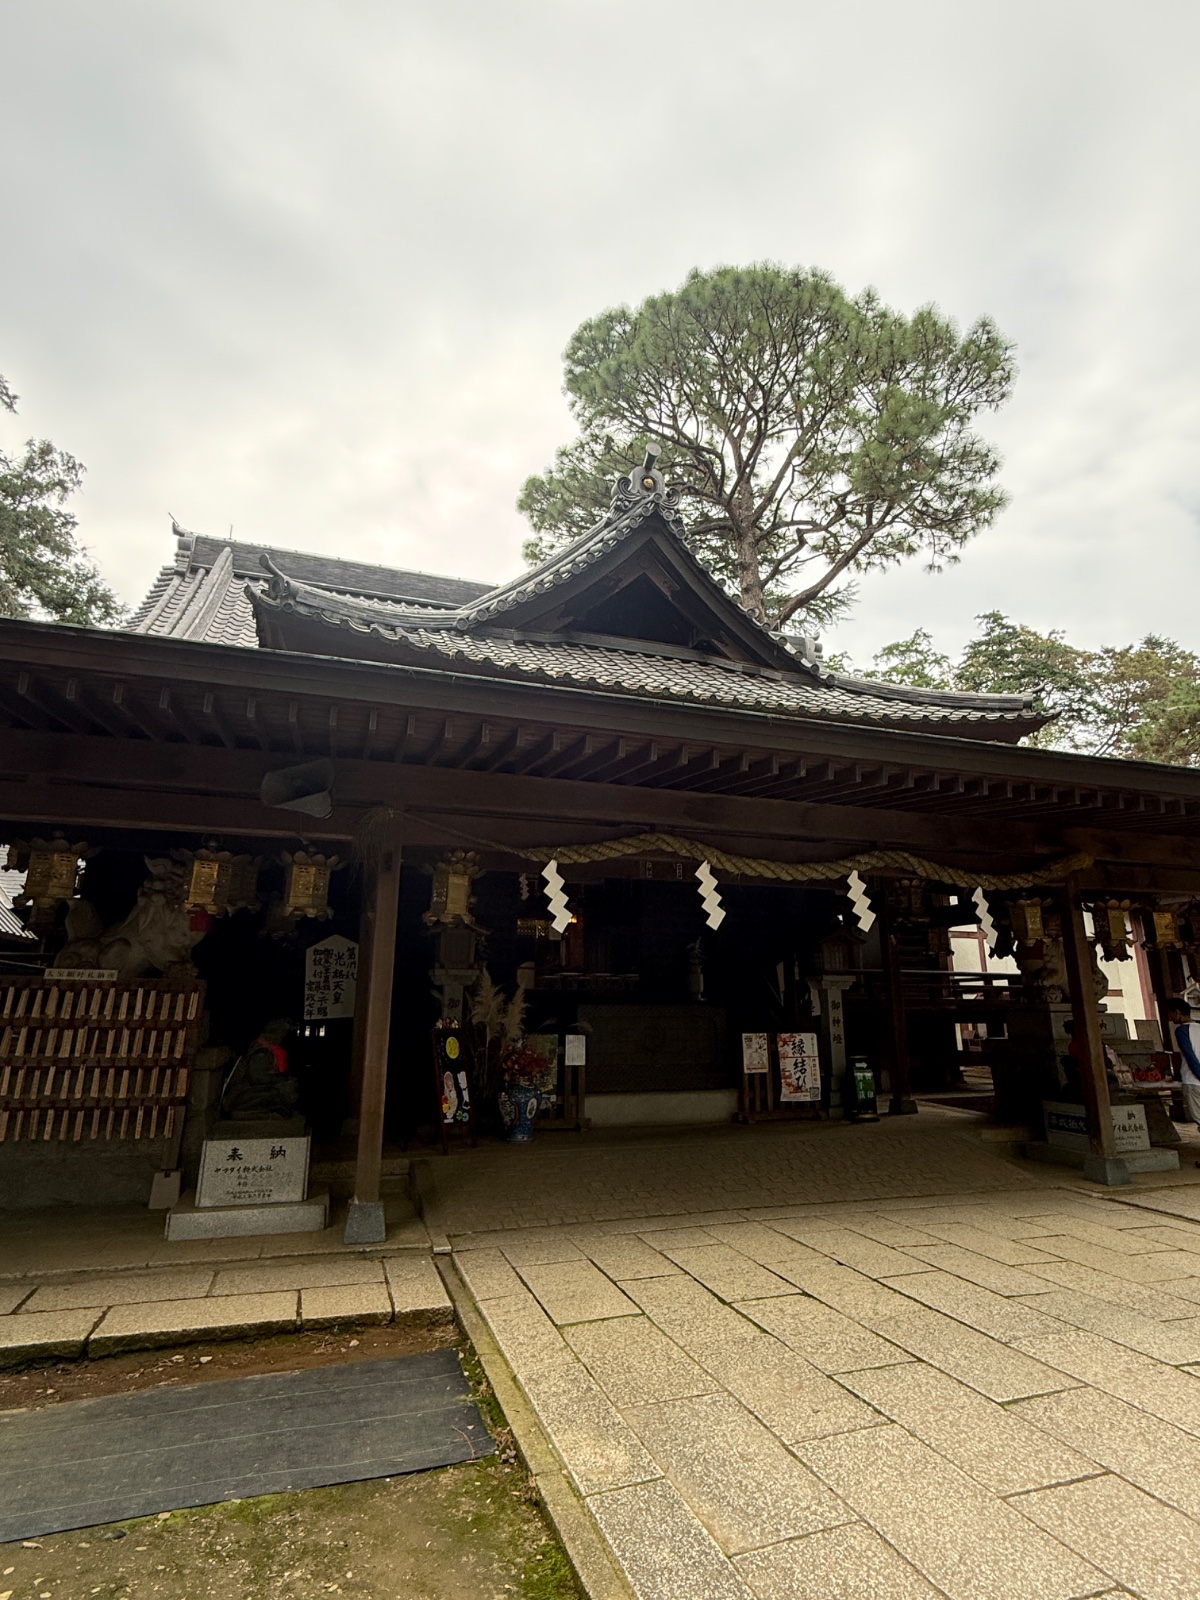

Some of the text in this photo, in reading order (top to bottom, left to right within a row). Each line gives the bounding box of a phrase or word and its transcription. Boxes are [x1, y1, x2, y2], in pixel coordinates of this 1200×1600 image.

[332, 952, 346, 1005] 光格天皇
[791, 1038, 807, 1090] 縁結び
